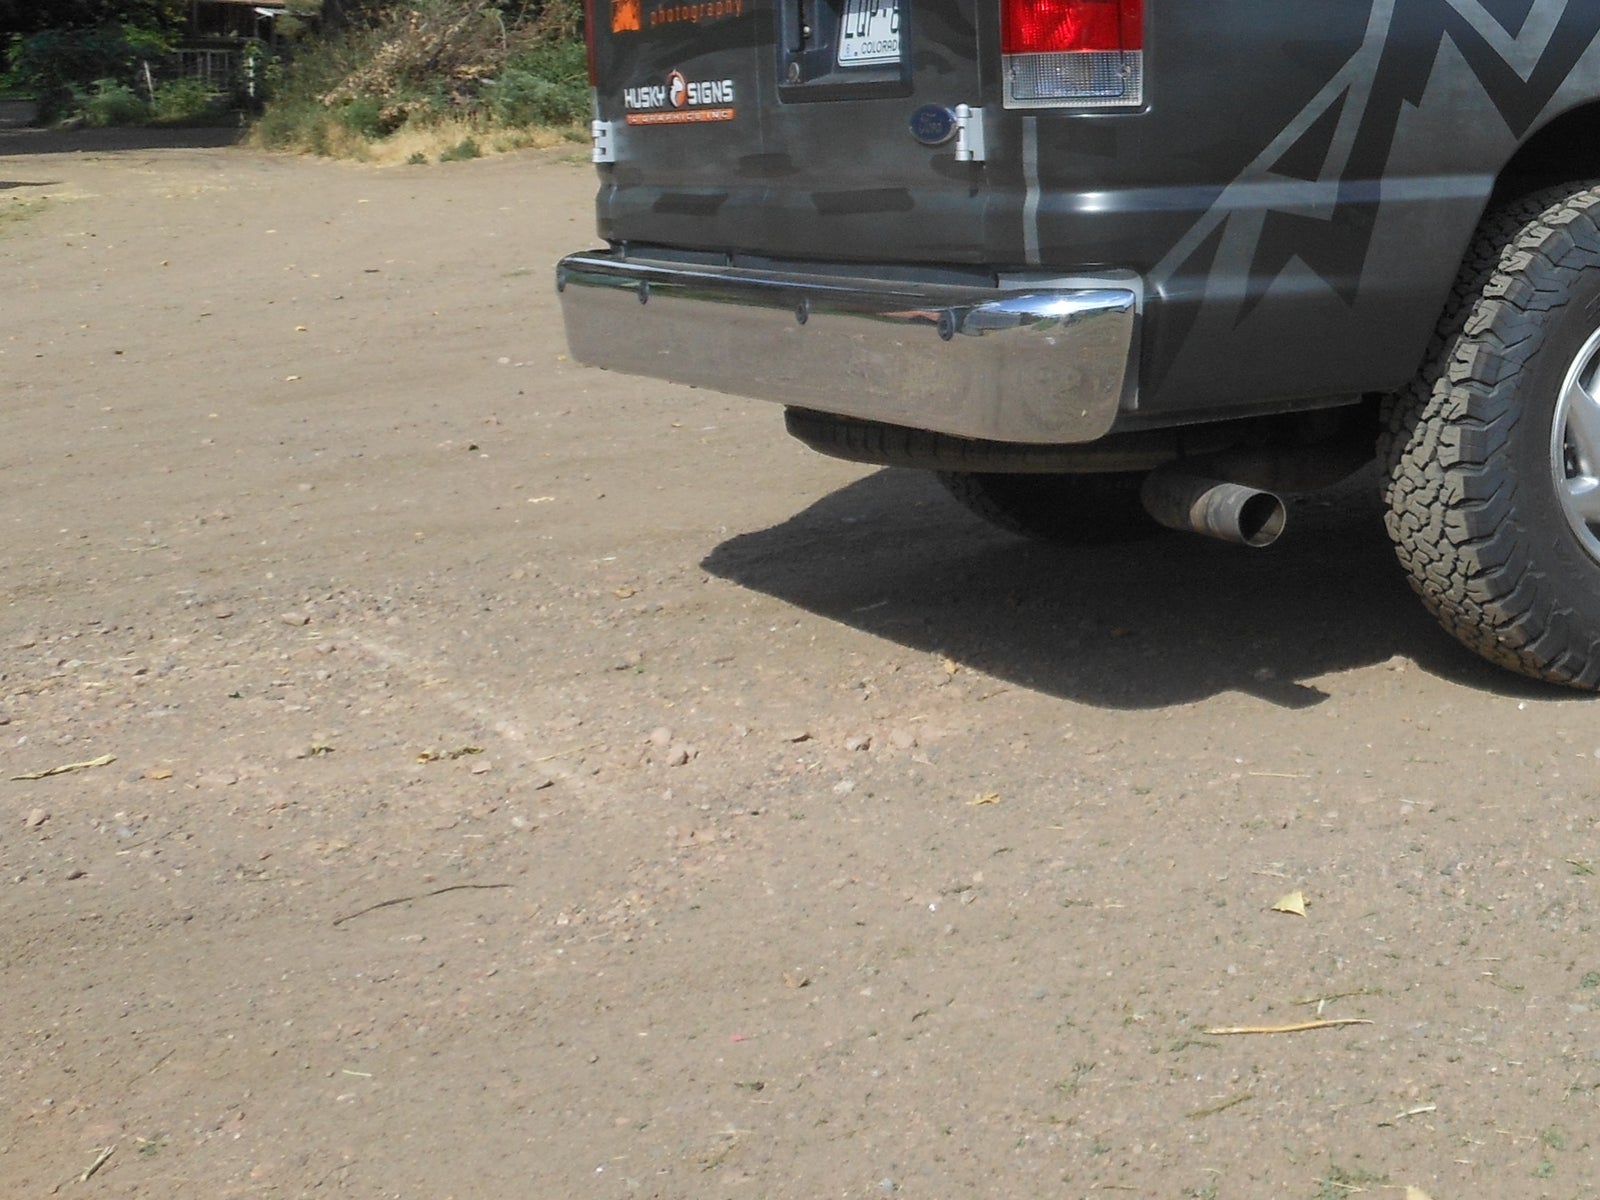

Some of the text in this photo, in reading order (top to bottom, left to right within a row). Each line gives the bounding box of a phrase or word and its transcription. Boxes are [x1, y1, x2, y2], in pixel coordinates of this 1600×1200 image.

[861, 39, 898, 54] COLORAD
[623, 80, 734, 109] HUSKY SIGNS
[642, 111, 701, 123] GRAPHICS
[706, 110, 728, 119] INC
